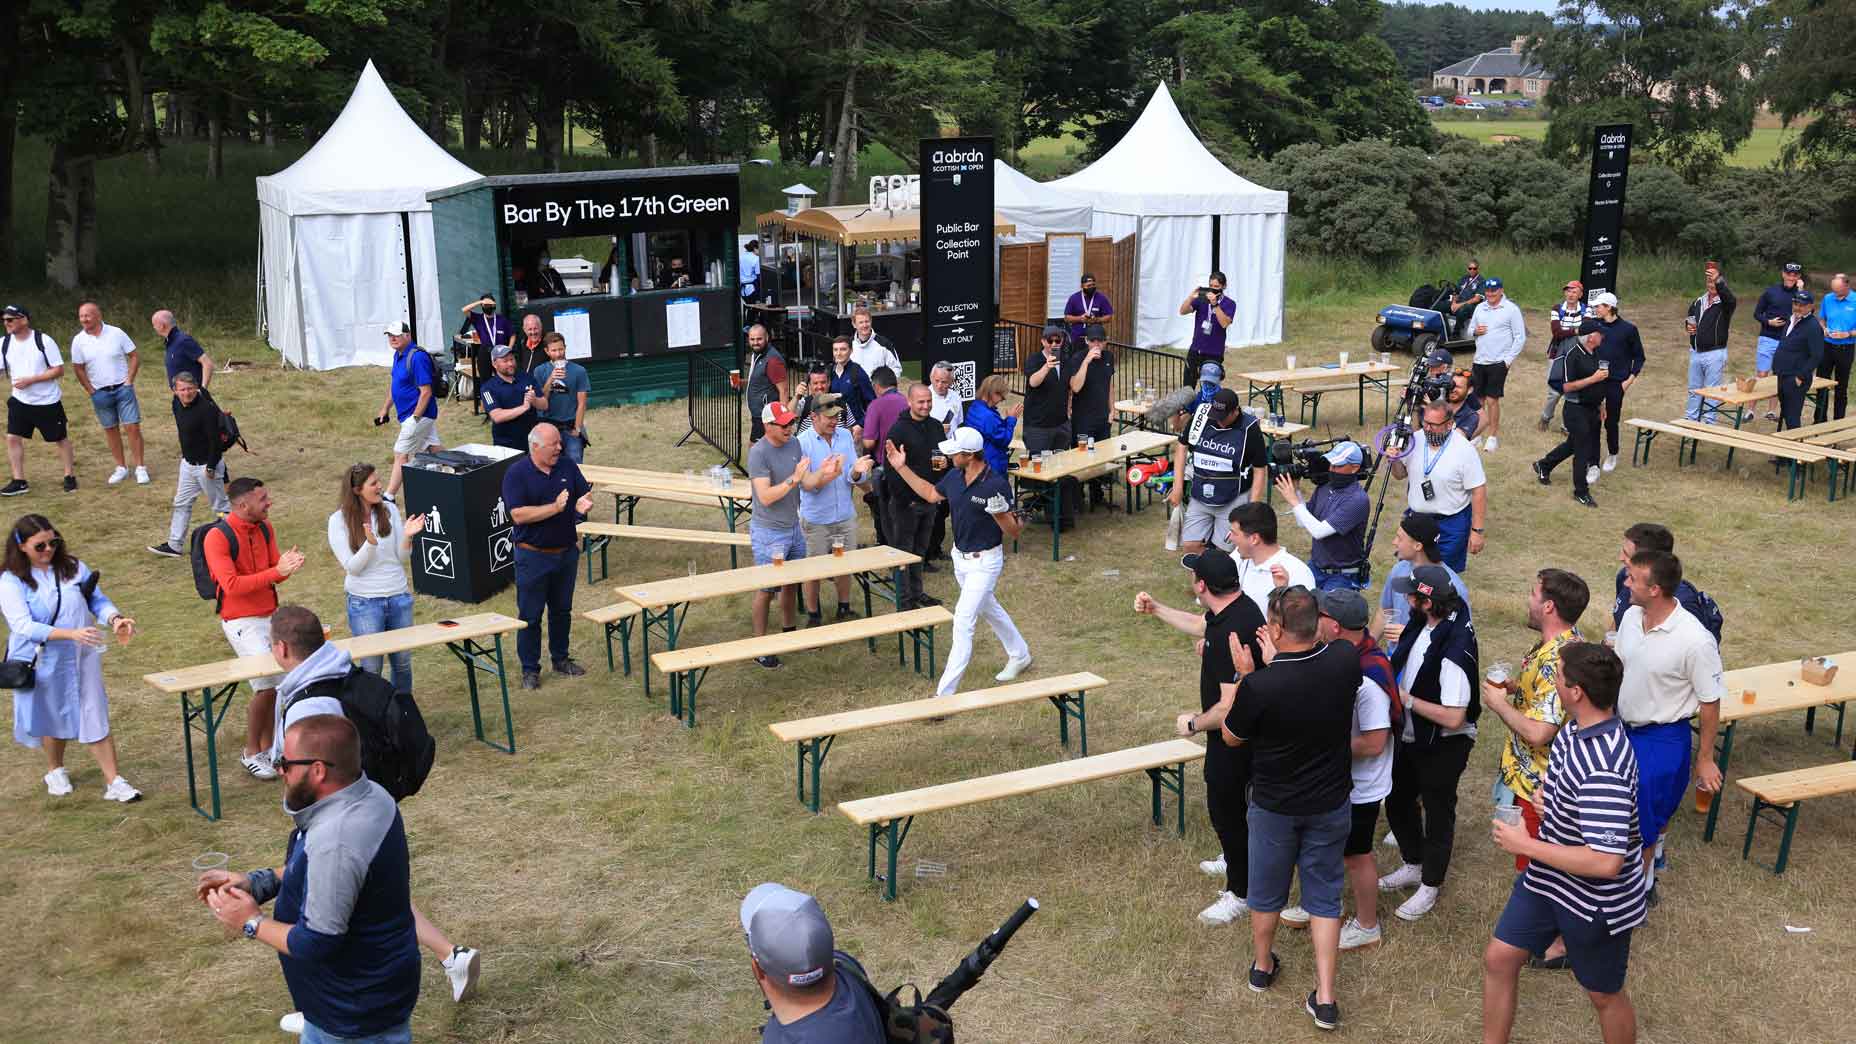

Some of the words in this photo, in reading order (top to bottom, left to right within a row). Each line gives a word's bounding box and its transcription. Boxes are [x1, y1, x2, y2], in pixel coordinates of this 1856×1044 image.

[968, 163, 984, 171] OPEN
[503, 204, 542, 224] Bar
[545, 201, 572, 226] By
[575, 199, 615, 219] The
[619, 196, 665, 217] 17th
[667, 194, 730, 213] Green
[936, 223, 963, 234] Public
[964, 221, 980, 232] Bar
[936, 238, 980, 250] Collection
[947, 249, 969, 260] Point
[937, 302, 979, 313] COLLECTION
[942, 336, 956, 345] EXIT
[956, 335, 974, 343] ONLY
